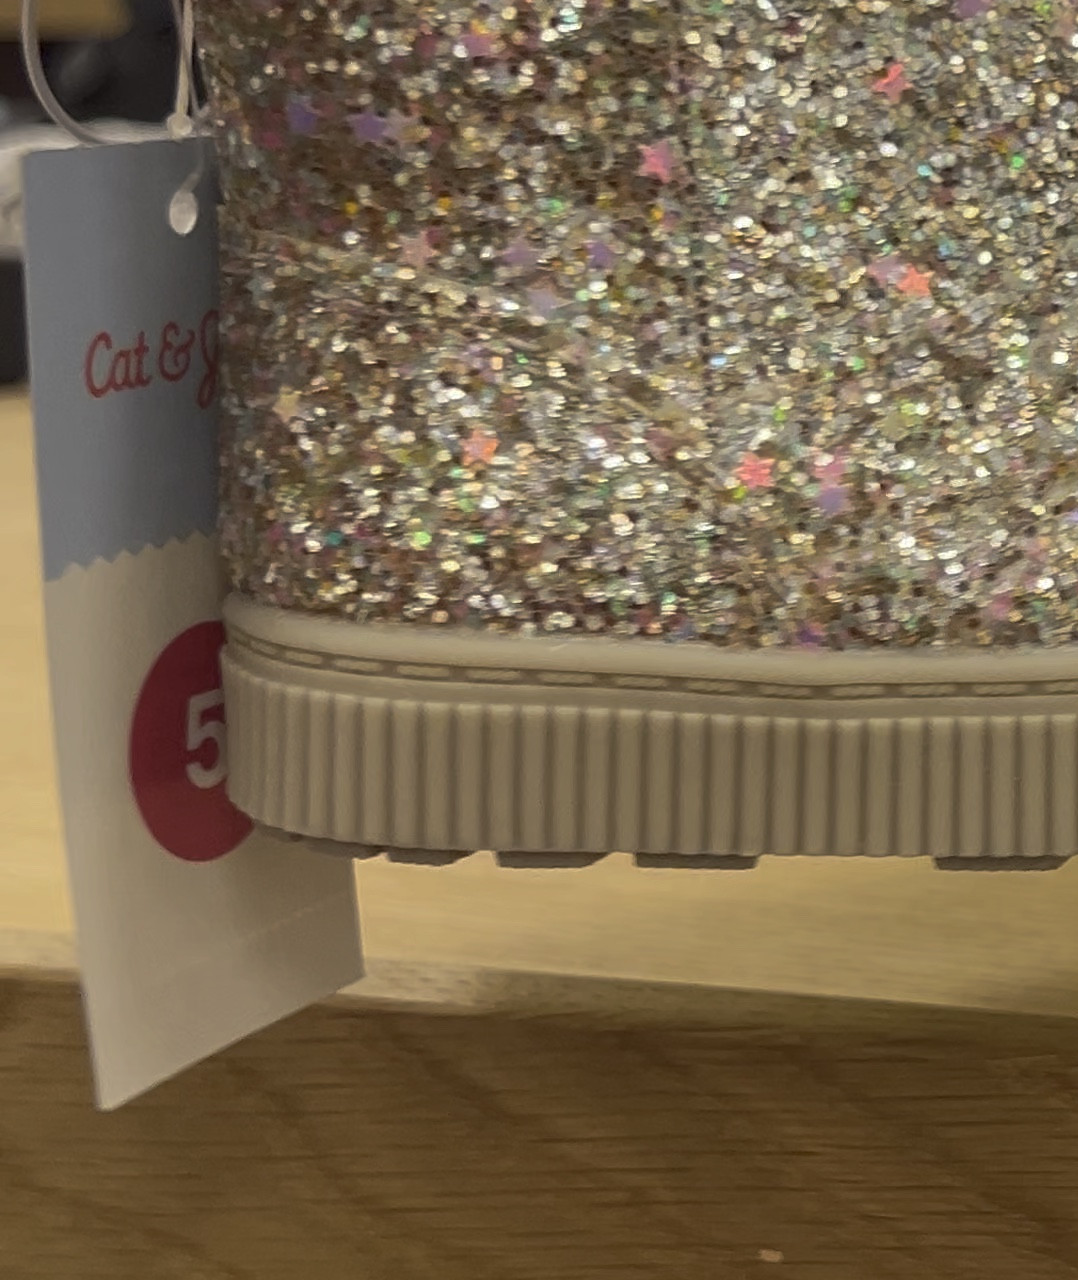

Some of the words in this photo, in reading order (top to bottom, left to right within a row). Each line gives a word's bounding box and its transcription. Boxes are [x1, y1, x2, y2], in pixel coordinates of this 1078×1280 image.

[83, 330, 153, 398] Cat
[158, 320, 196, 382] &
[186, 689, 228, 789] 5
